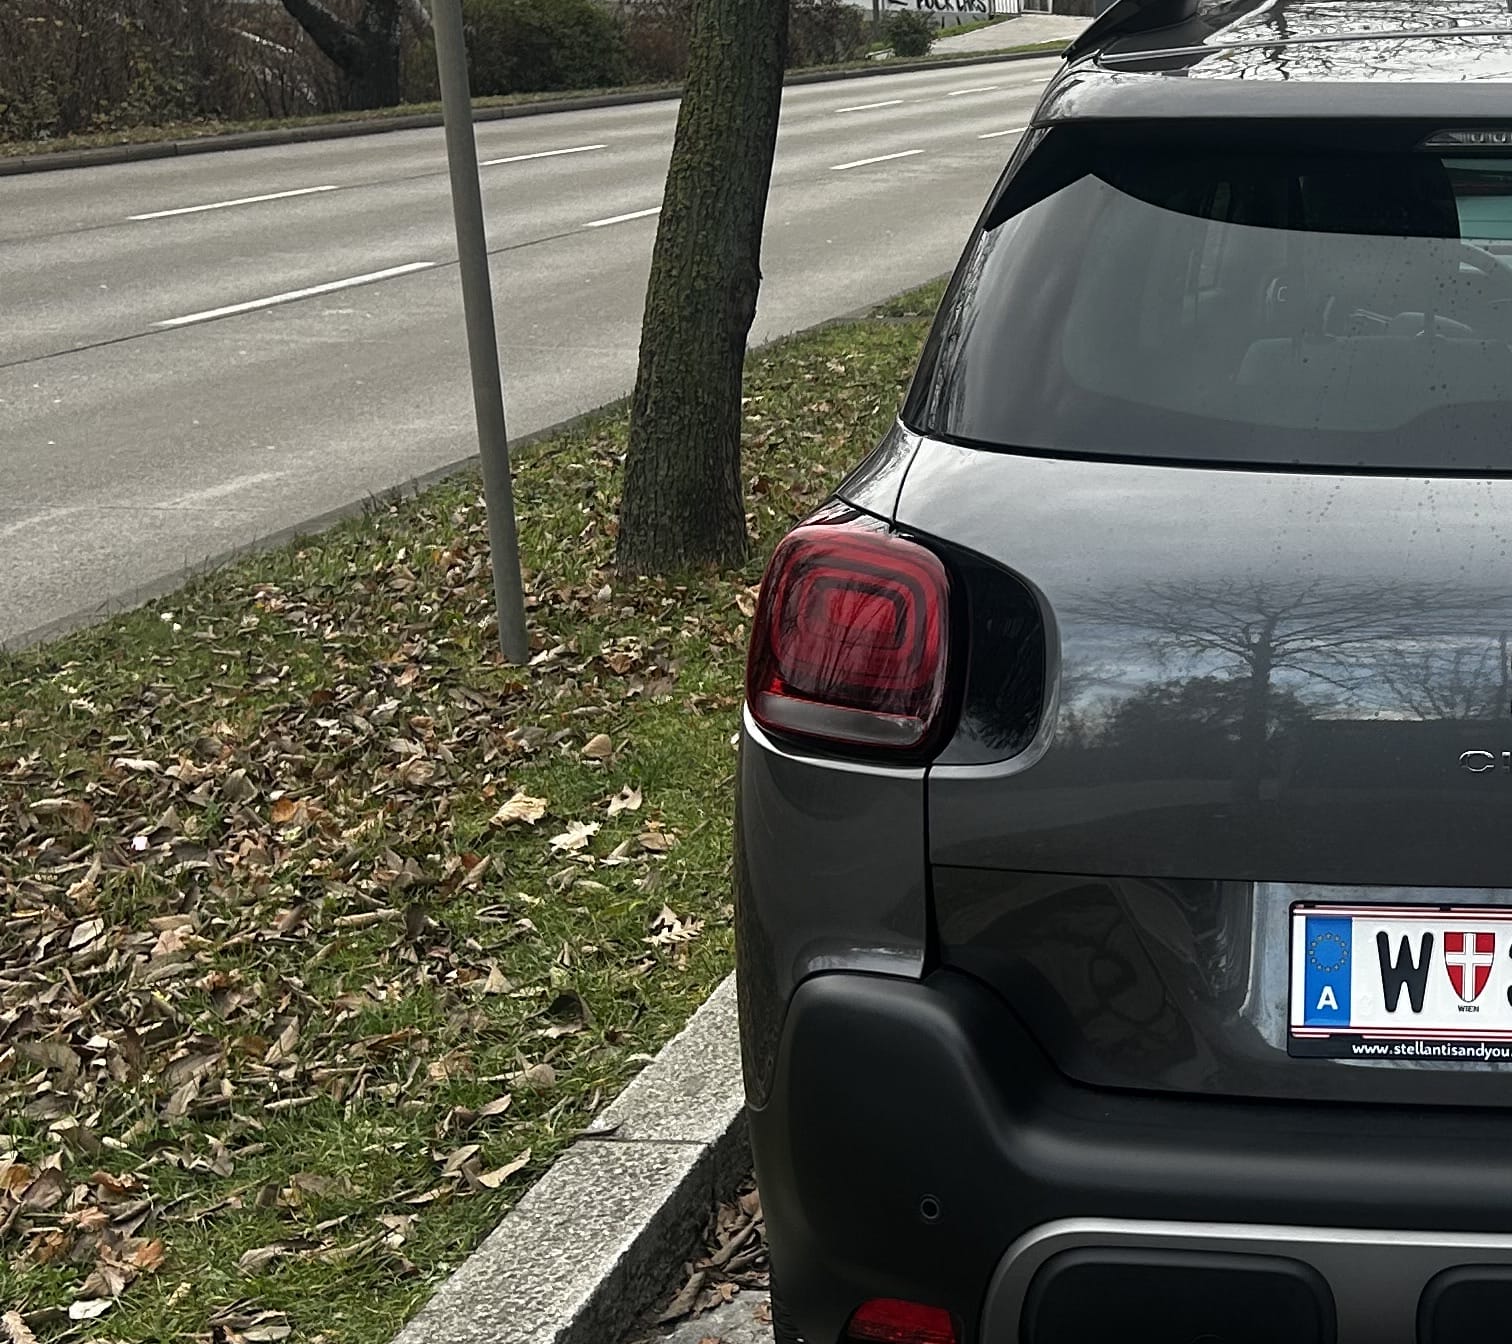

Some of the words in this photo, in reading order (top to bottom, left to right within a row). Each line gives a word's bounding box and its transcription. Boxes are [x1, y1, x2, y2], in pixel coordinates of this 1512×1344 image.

[1376, 931, 1433, 1013] W
[1316, 987, 1338, 1010] A
[1457, 1004, 1480, 1013] WIEN
